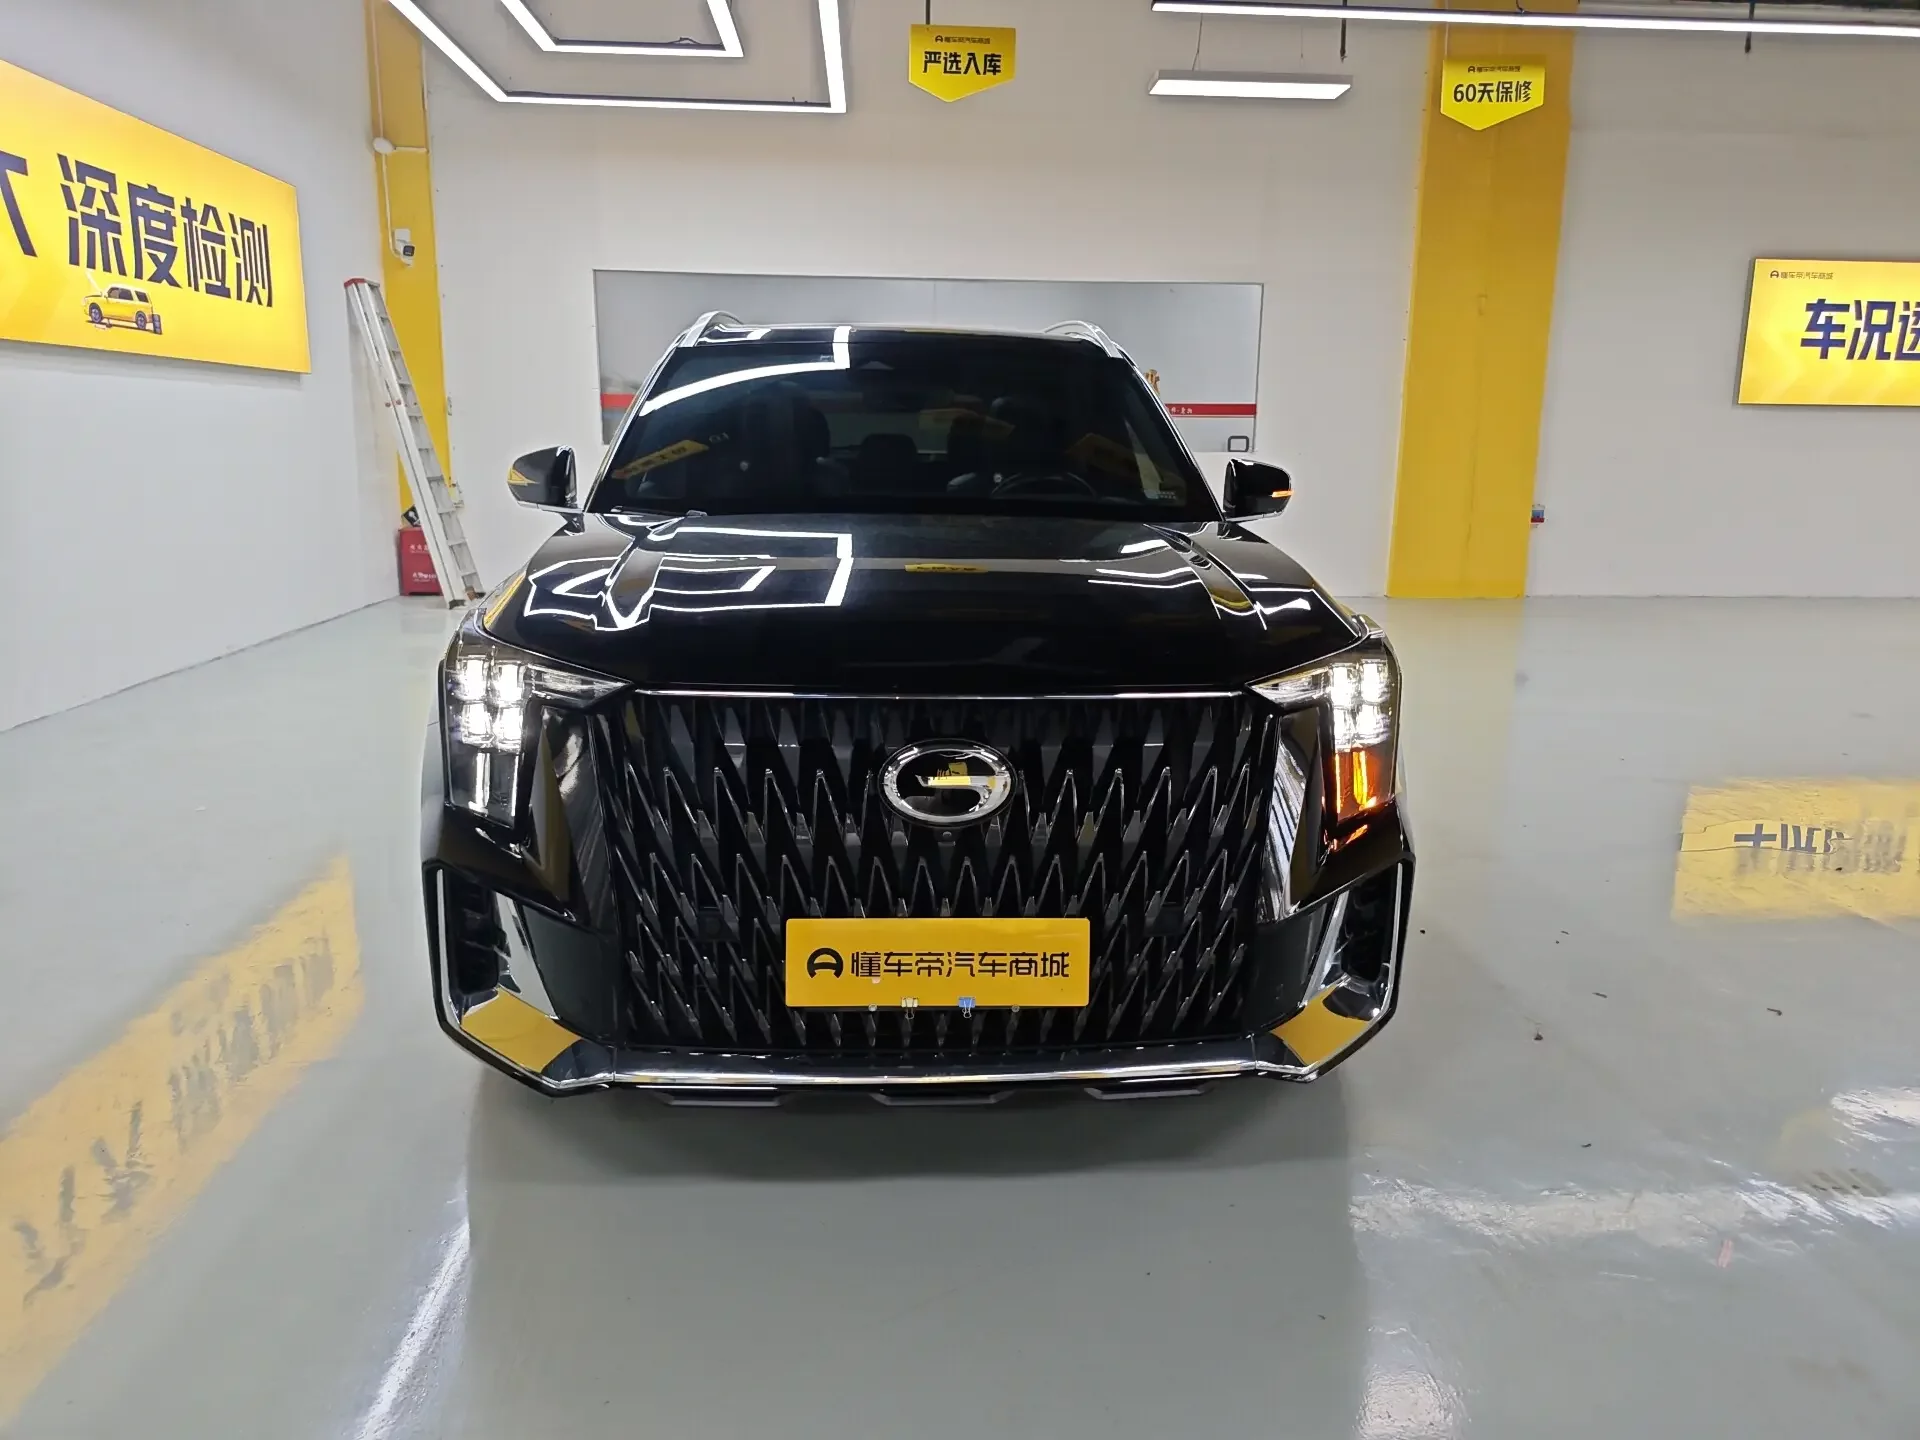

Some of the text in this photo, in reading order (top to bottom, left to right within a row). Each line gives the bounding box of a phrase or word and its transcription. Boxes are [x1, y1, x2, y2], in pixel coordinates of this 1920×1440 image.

[923, 51, 1002, 75] 严选入库
[1453, 81, 1532, 103] 60天保修
[57, 152, 273, 308] 深度检测
[851, 951, 1070, 978] 懂车帝汽车商城
